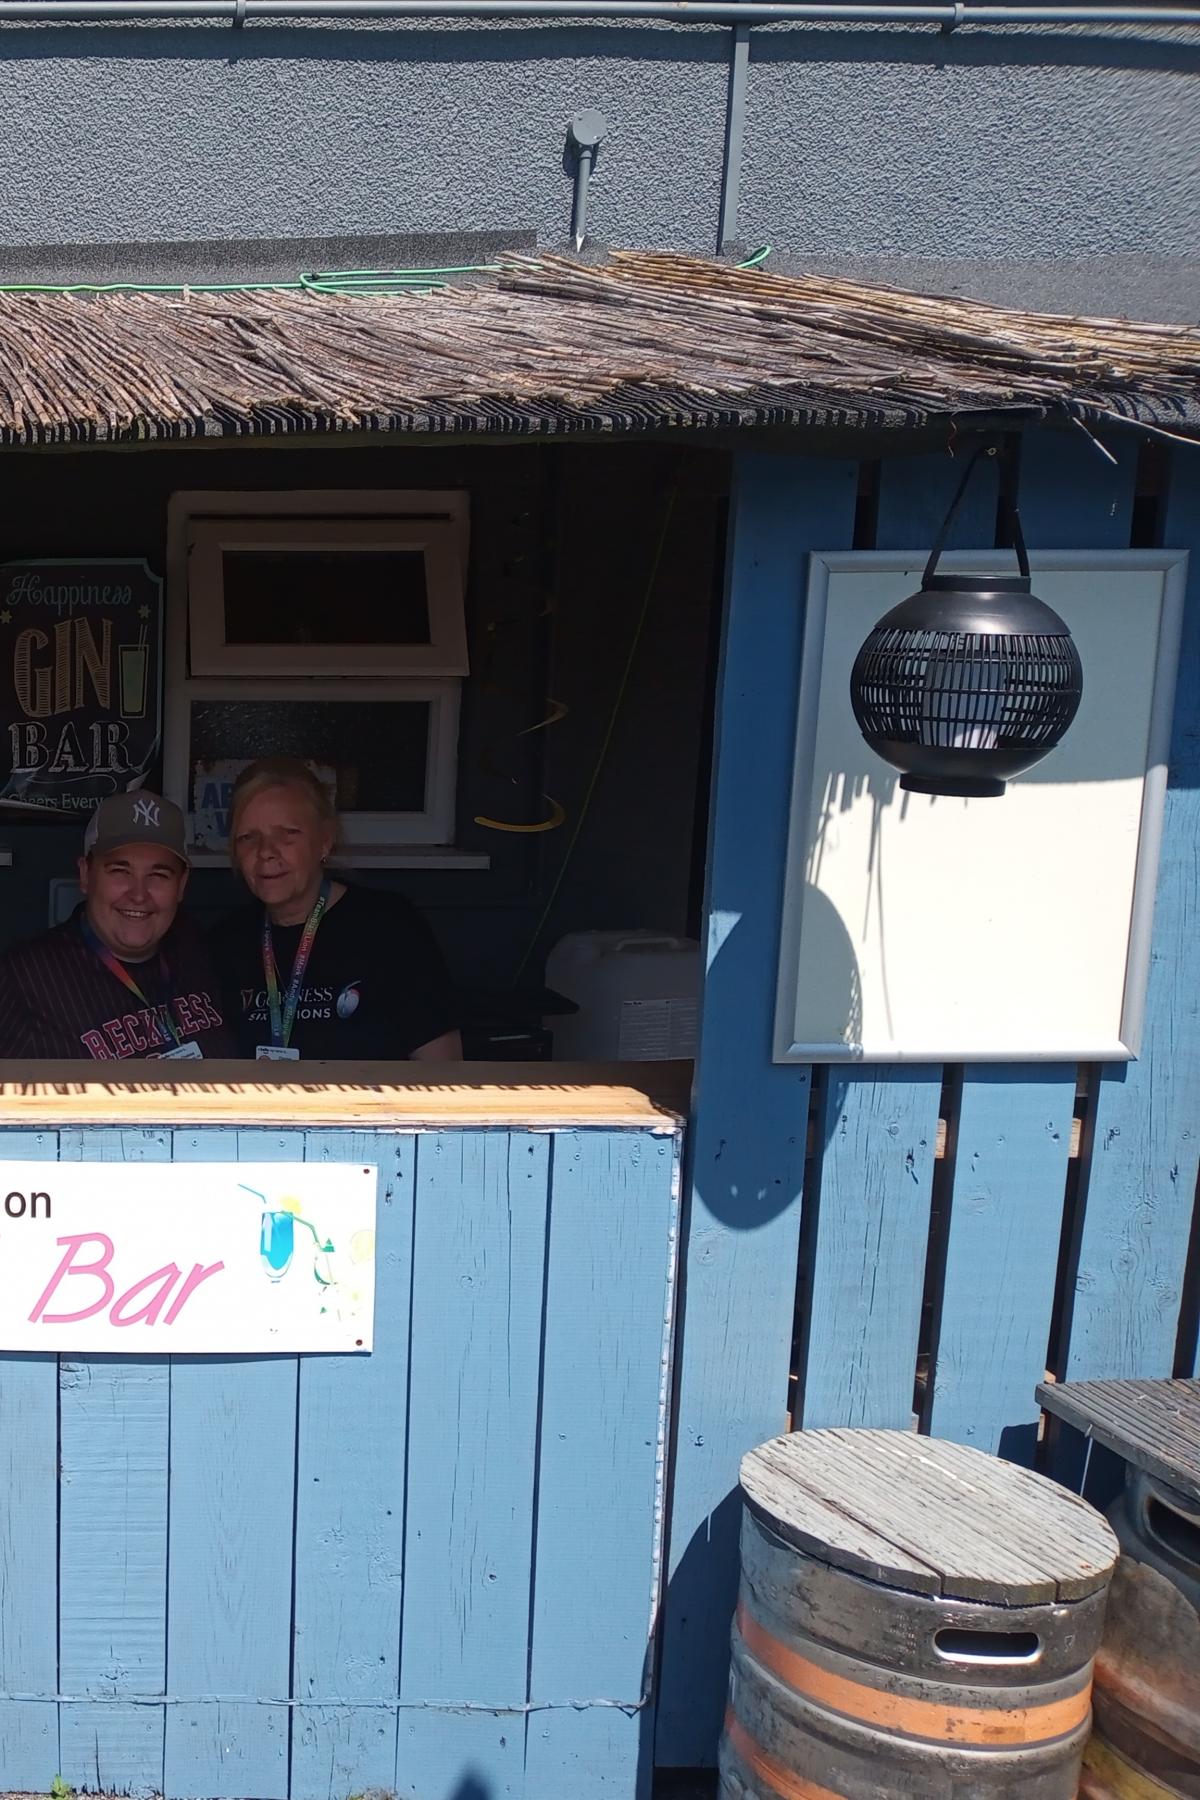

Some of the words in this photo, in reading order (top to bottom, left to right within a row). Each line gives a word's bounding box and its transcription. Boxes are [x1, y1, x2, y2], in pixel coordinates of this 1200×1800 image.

[7, 572, 132, 616] Happiness
[13, 616, 113, 718] GIN
[8, 721, 135, 774] BAR
[132, 798, 160, 826] NY
[27, 1232, 225, 1327] Bar
